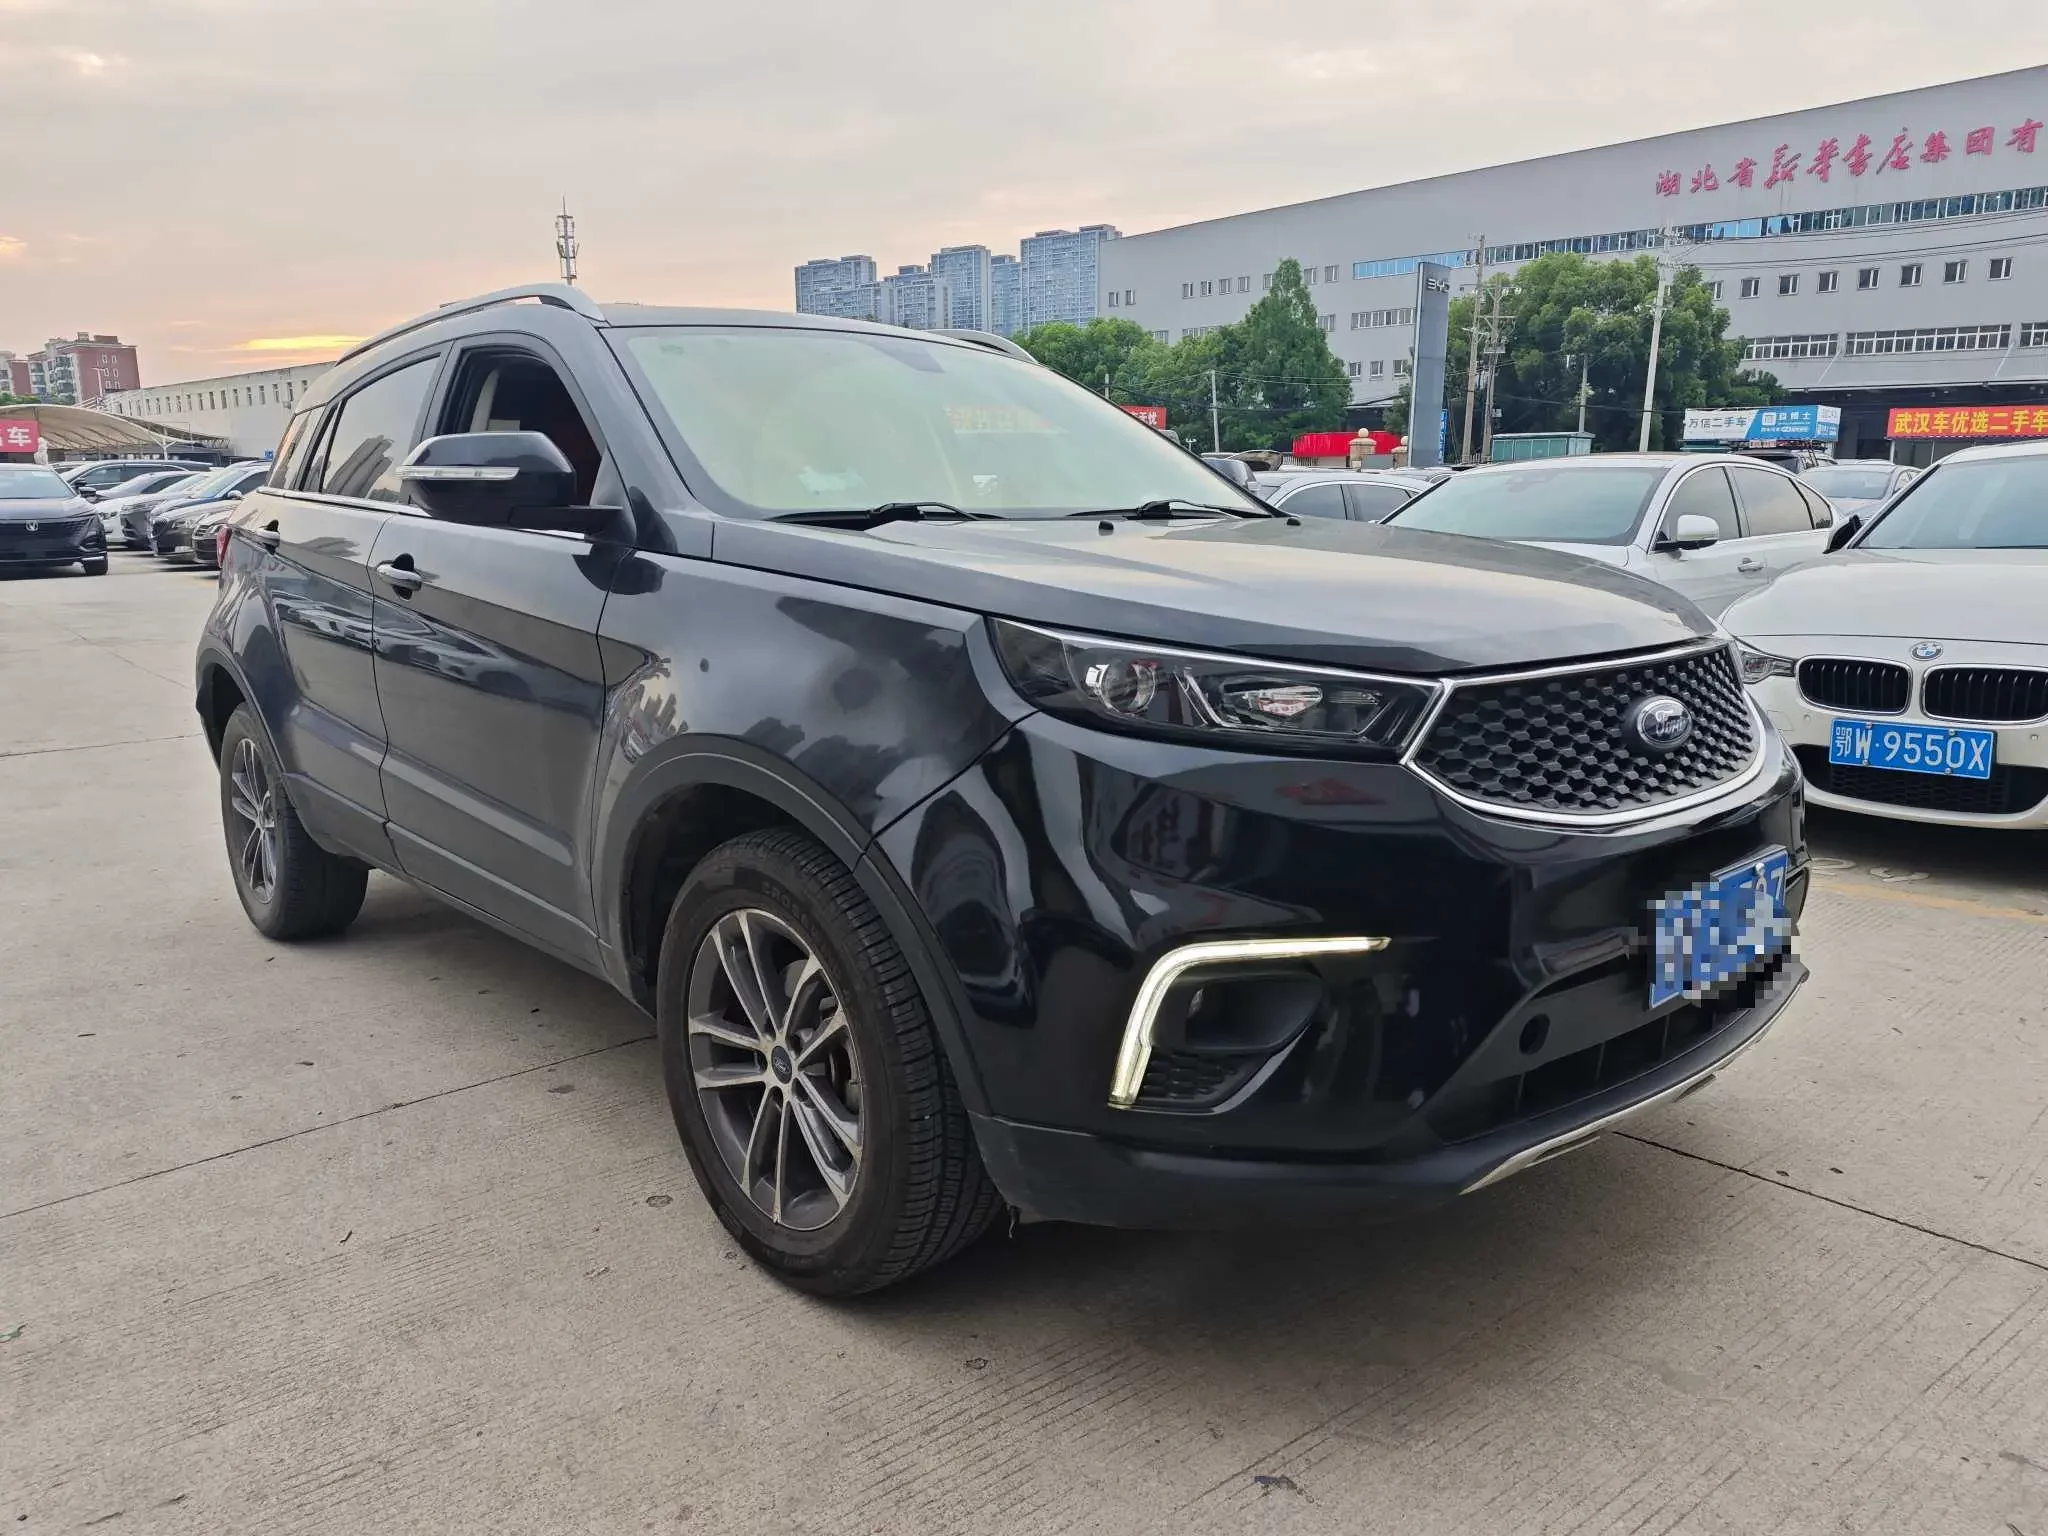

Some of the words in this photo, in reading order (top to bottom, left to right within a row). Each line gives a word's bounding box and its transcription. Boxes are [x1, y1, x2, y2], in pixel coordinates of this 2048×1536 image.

[1894, 408, 2048, 434] 武汉车优选二手车
[0, 426, 31, 446] 车
